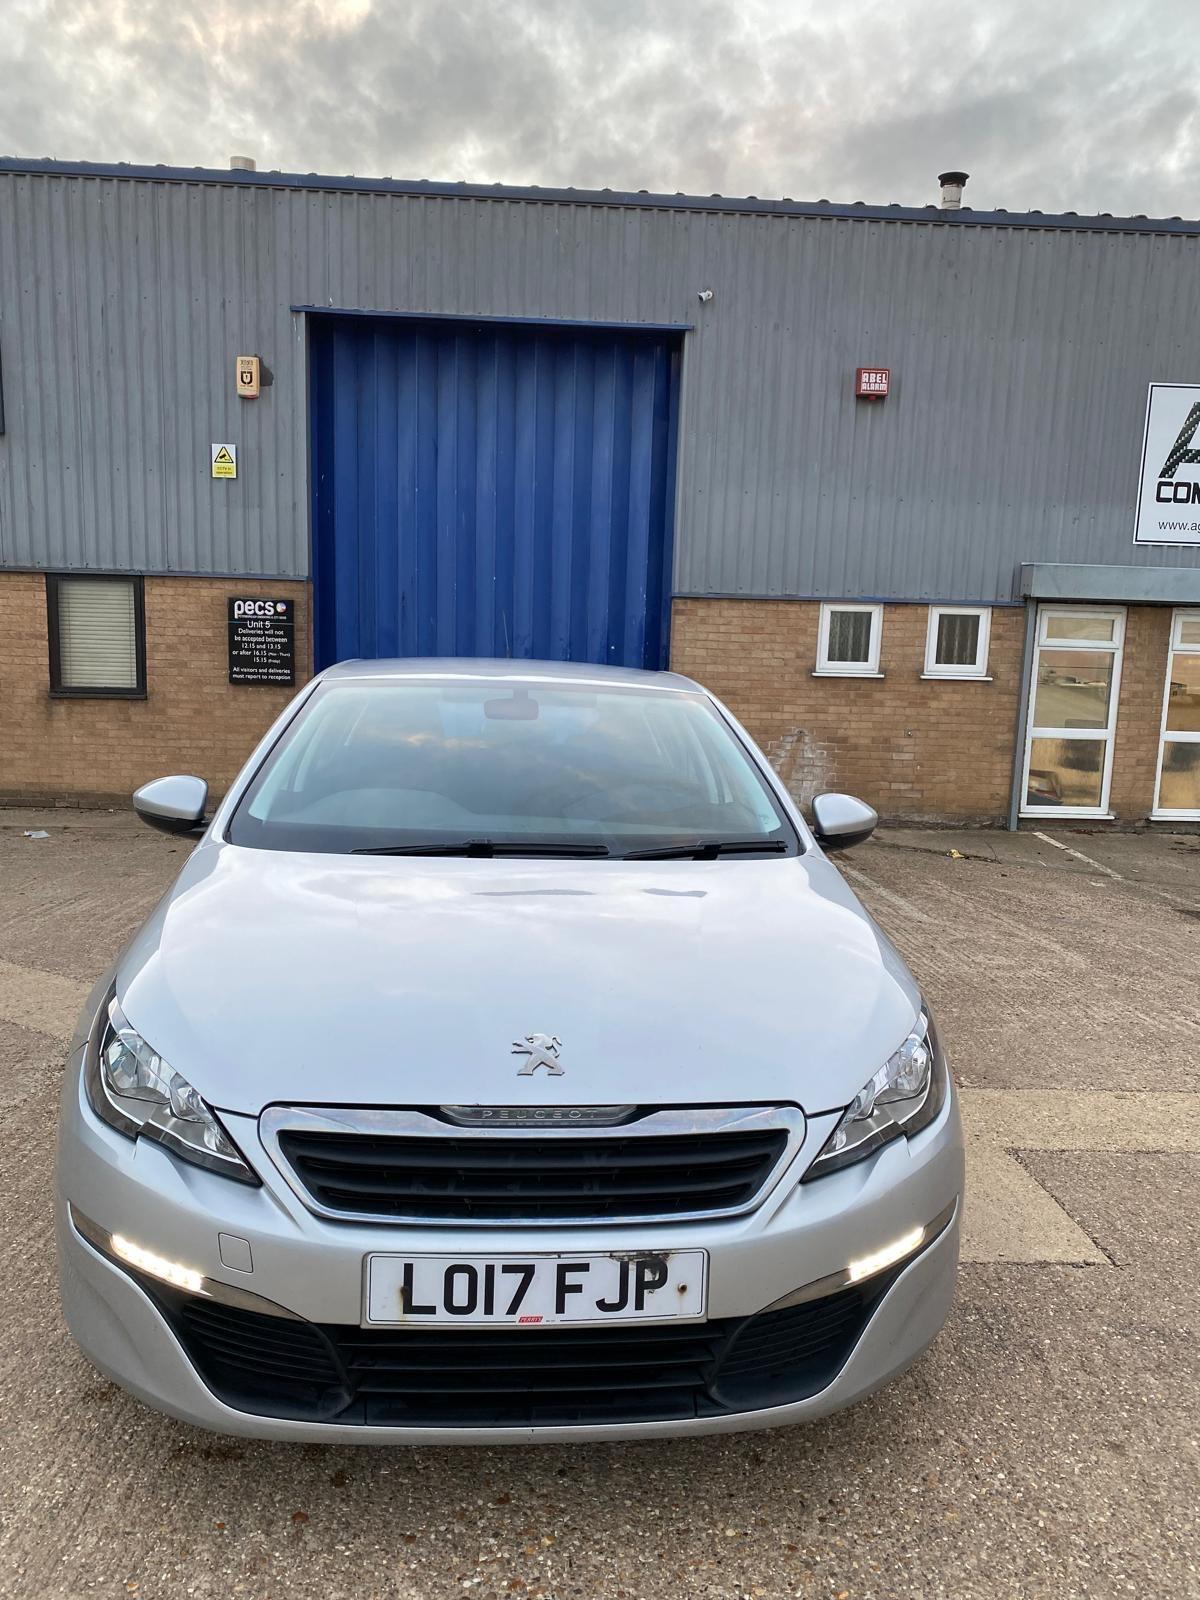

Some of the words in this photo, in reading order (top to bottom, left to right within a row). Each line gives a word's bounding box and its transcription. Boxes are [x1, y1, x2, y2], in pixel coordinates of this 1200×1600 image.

[863, 372, 887, 383] ABEL
[862, 382, 888, 391] ALARM
[234, 600, 274, 619] pecs
[481, 1110, 598, 1119] PEUGEOT
[402, 1262, 536, 1315] LO17
[556, 1259, 668, 1314] FJP
